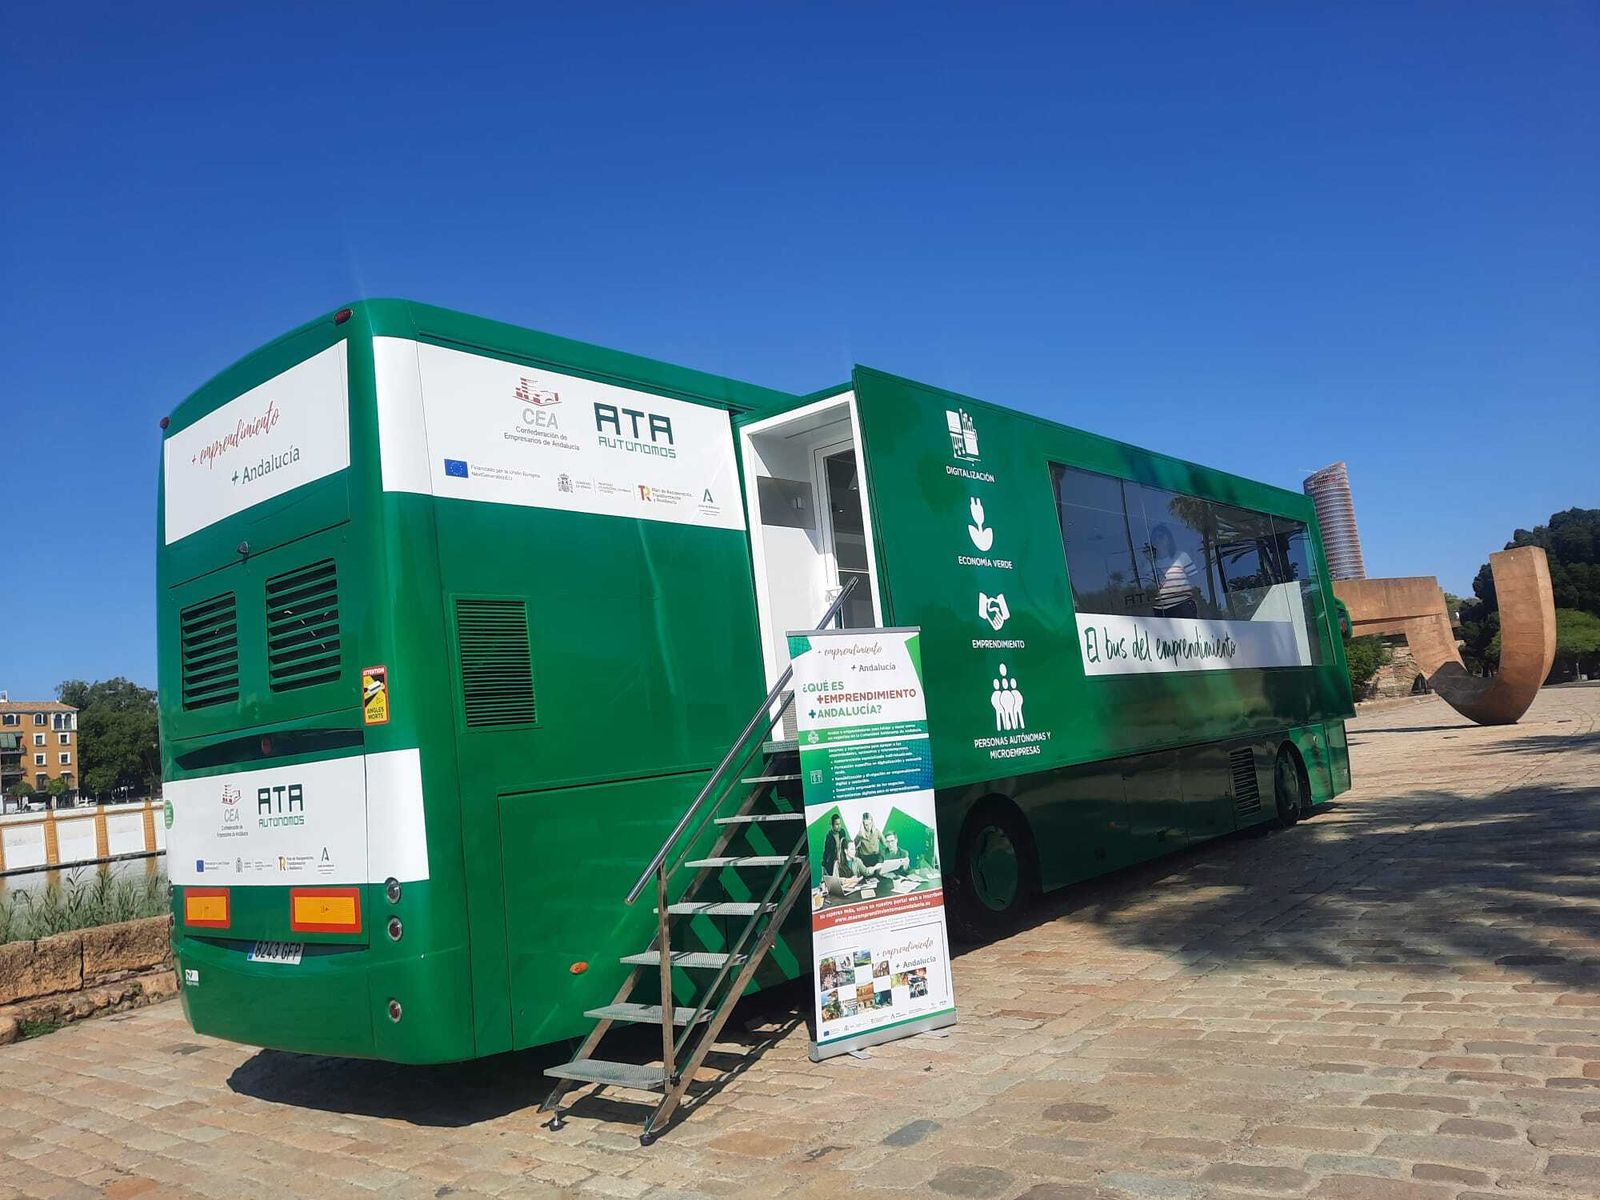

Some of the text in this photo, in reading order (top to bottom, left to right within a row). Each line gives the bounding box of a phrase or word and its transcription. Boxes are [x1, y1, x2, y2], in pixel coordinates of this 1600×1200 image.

[522, 408, 558, 429] CEA
[594, 402, 674, 445] ATA
[200, 400, 280, 470] emprendimiento
[504, 433, 542, 445] Empresarios
[242, 445, 300, 484] Andalucía
[946, 466, 995, 483] DIGITALIZACIÓN
[958, 556, 1013, 569] ECONOMÍA VERDE
[972, 639, 1024, 648] EMPRENDIMIENTO
[1085, 624, 1237, 666] El bus del emprendimiento
[859, 662, 896, 672] Andalucía
[802, 680, 844, 693] ¿QUÉ ES
[974, 736, 1008, 748] PERSONAS
[1009, 730, 1046, 744] AUTÓNOMAS
[990, 746, 1040, 759] MICROEMPRESAS
[258, 784, 304, 815] ATA
[224, 808, 240, 823] CEA
[255, 941, 302, 960] 8243 GFP
